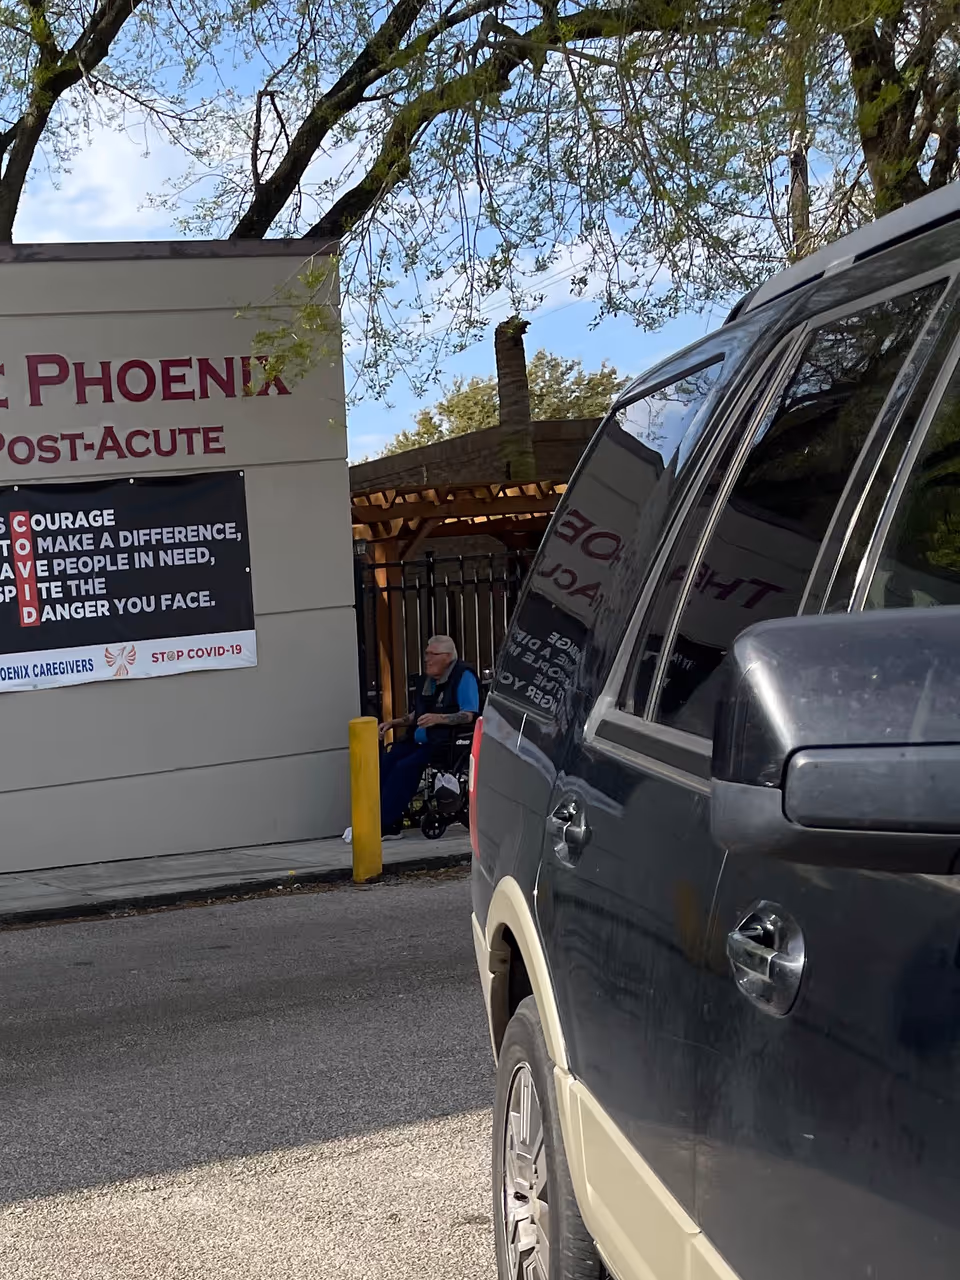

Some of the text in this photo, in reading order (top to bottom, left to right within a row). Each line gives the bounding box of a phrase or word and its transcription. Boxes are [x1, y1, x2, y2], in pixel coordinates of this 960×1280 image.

[24, 354, 292, 407] PHOENIX
[12, 509, 116, 533] COURAGE
[37, 533, 95, 554] MAKE
[99, 532, 115, 549] A
[118, 522, 242, 548] DIFFERENCE,
[53, 553, 130, 576] PEOPLE
[134, 551, 155, 568] IN
[159, 547, 216, 567] NEED,
[67, 577, 107, 597] THE
[22, 590, 216, 623] DANGER YOU FACE.
[187, 644, 243, 660] COVID-19
[32, 658, 94, 678] CAREGIVERS
